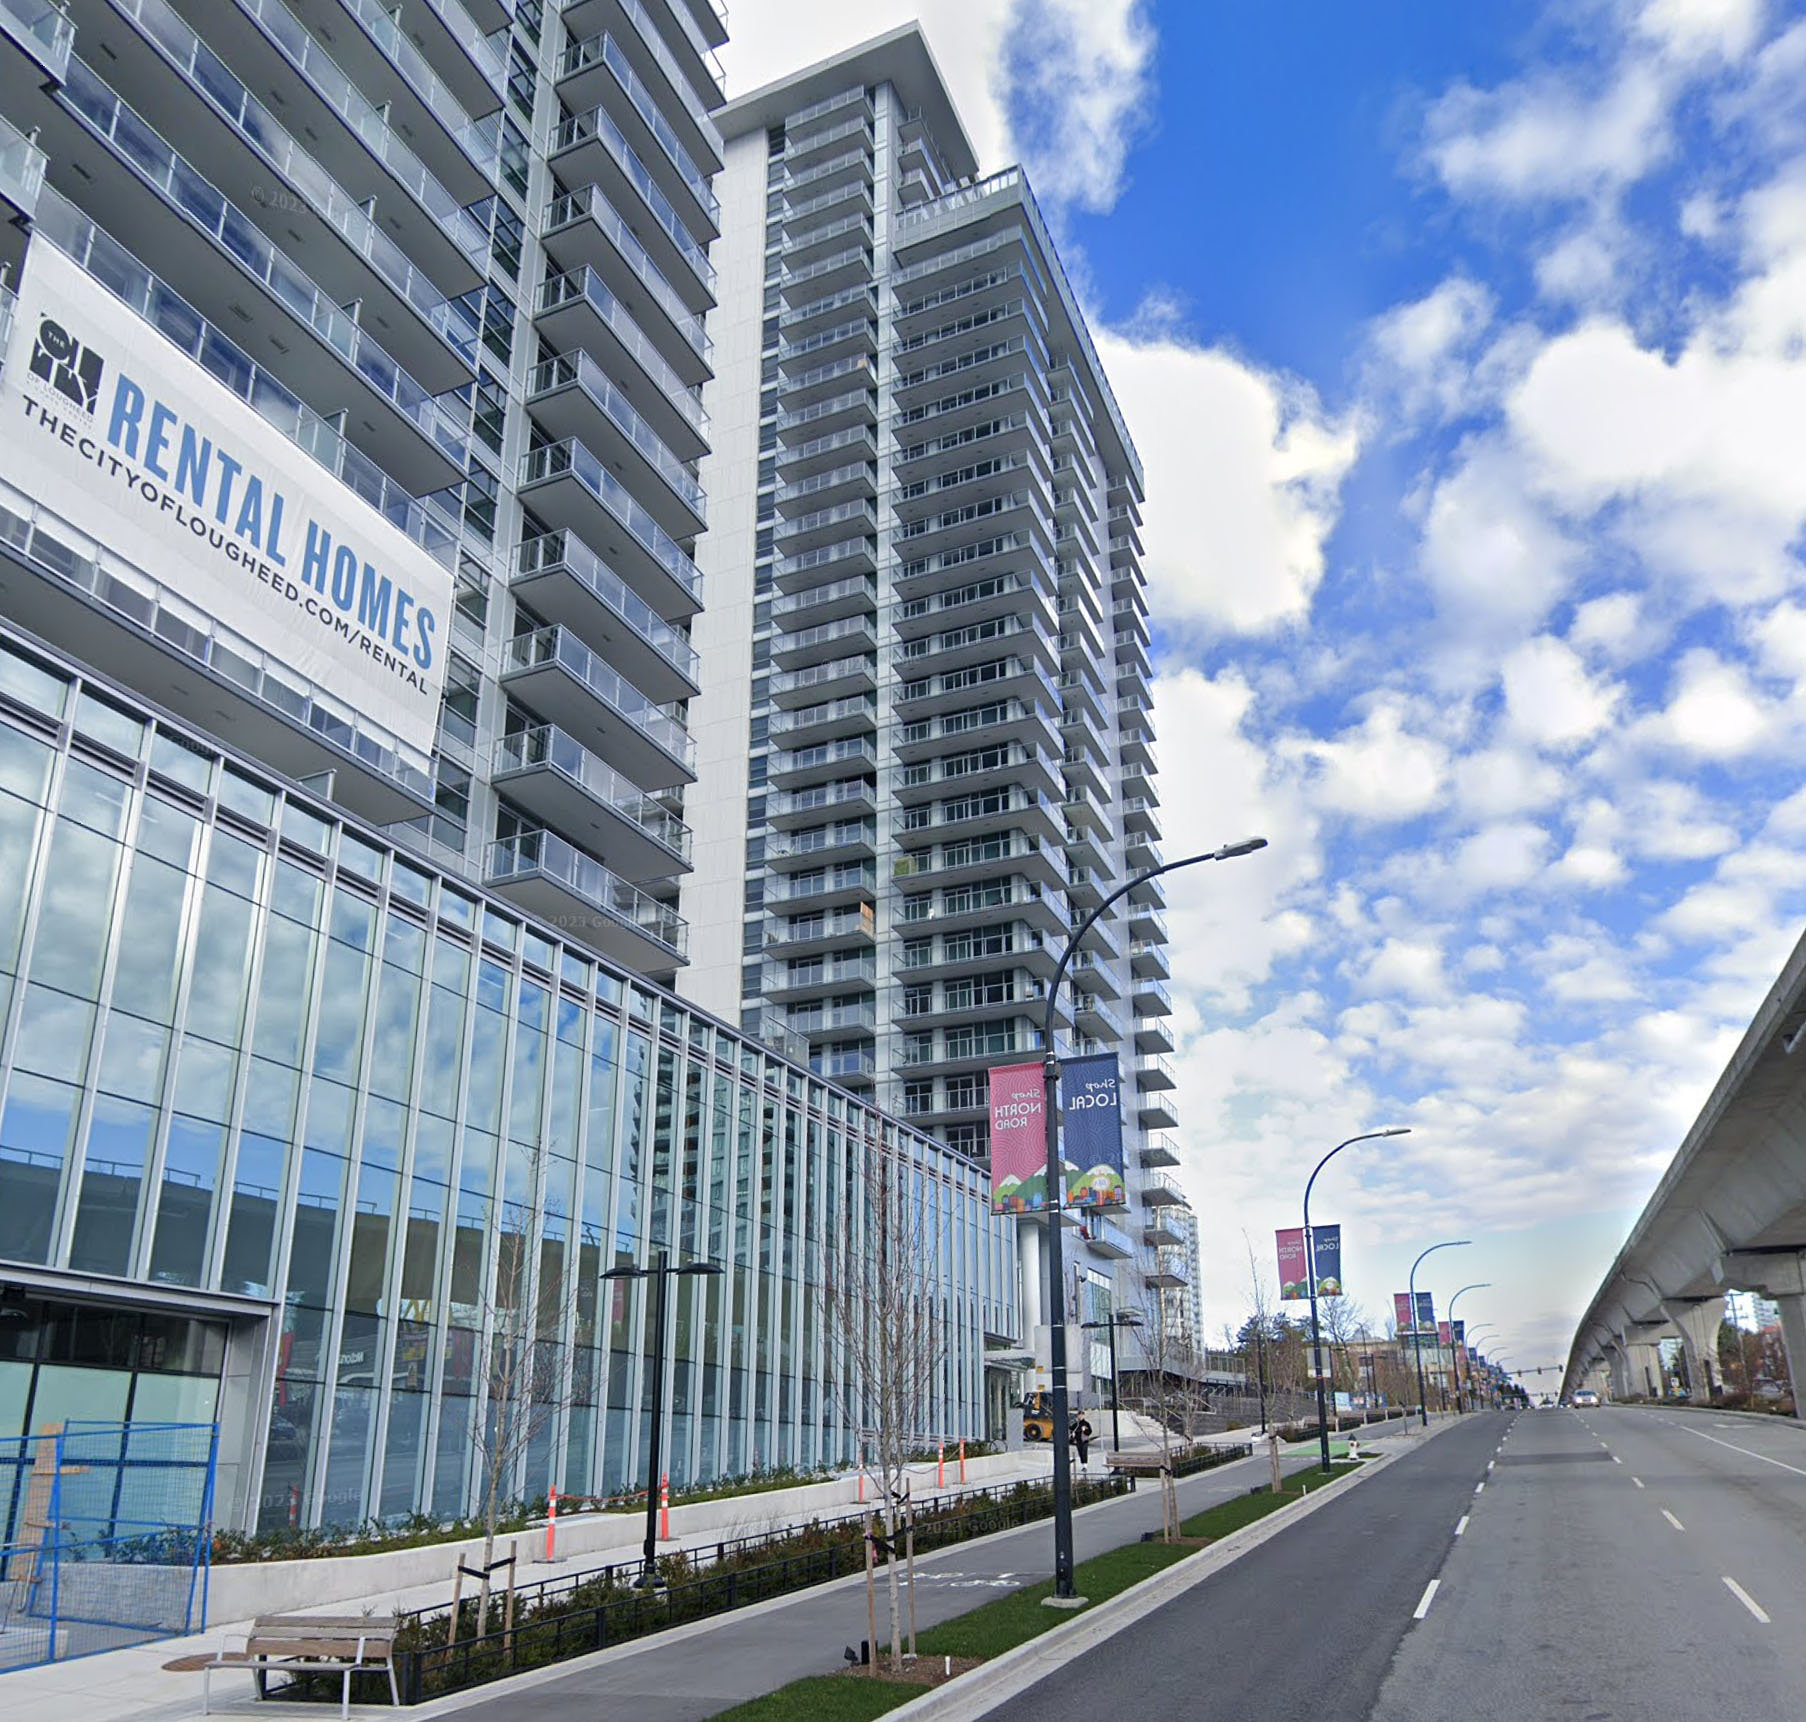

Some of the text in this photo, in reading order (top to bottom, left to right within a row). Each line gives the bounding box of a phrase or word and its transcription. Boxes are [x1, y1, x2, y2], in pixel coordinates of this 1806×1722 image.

[26, 373, 42, 387] OF
[48, 331, 65, 349] THE
[22, 394, 428, 696] THECITYOFLOUGHEED.COM/RENTAL
[108, 375, 436, 670] RENTAL HOMES
